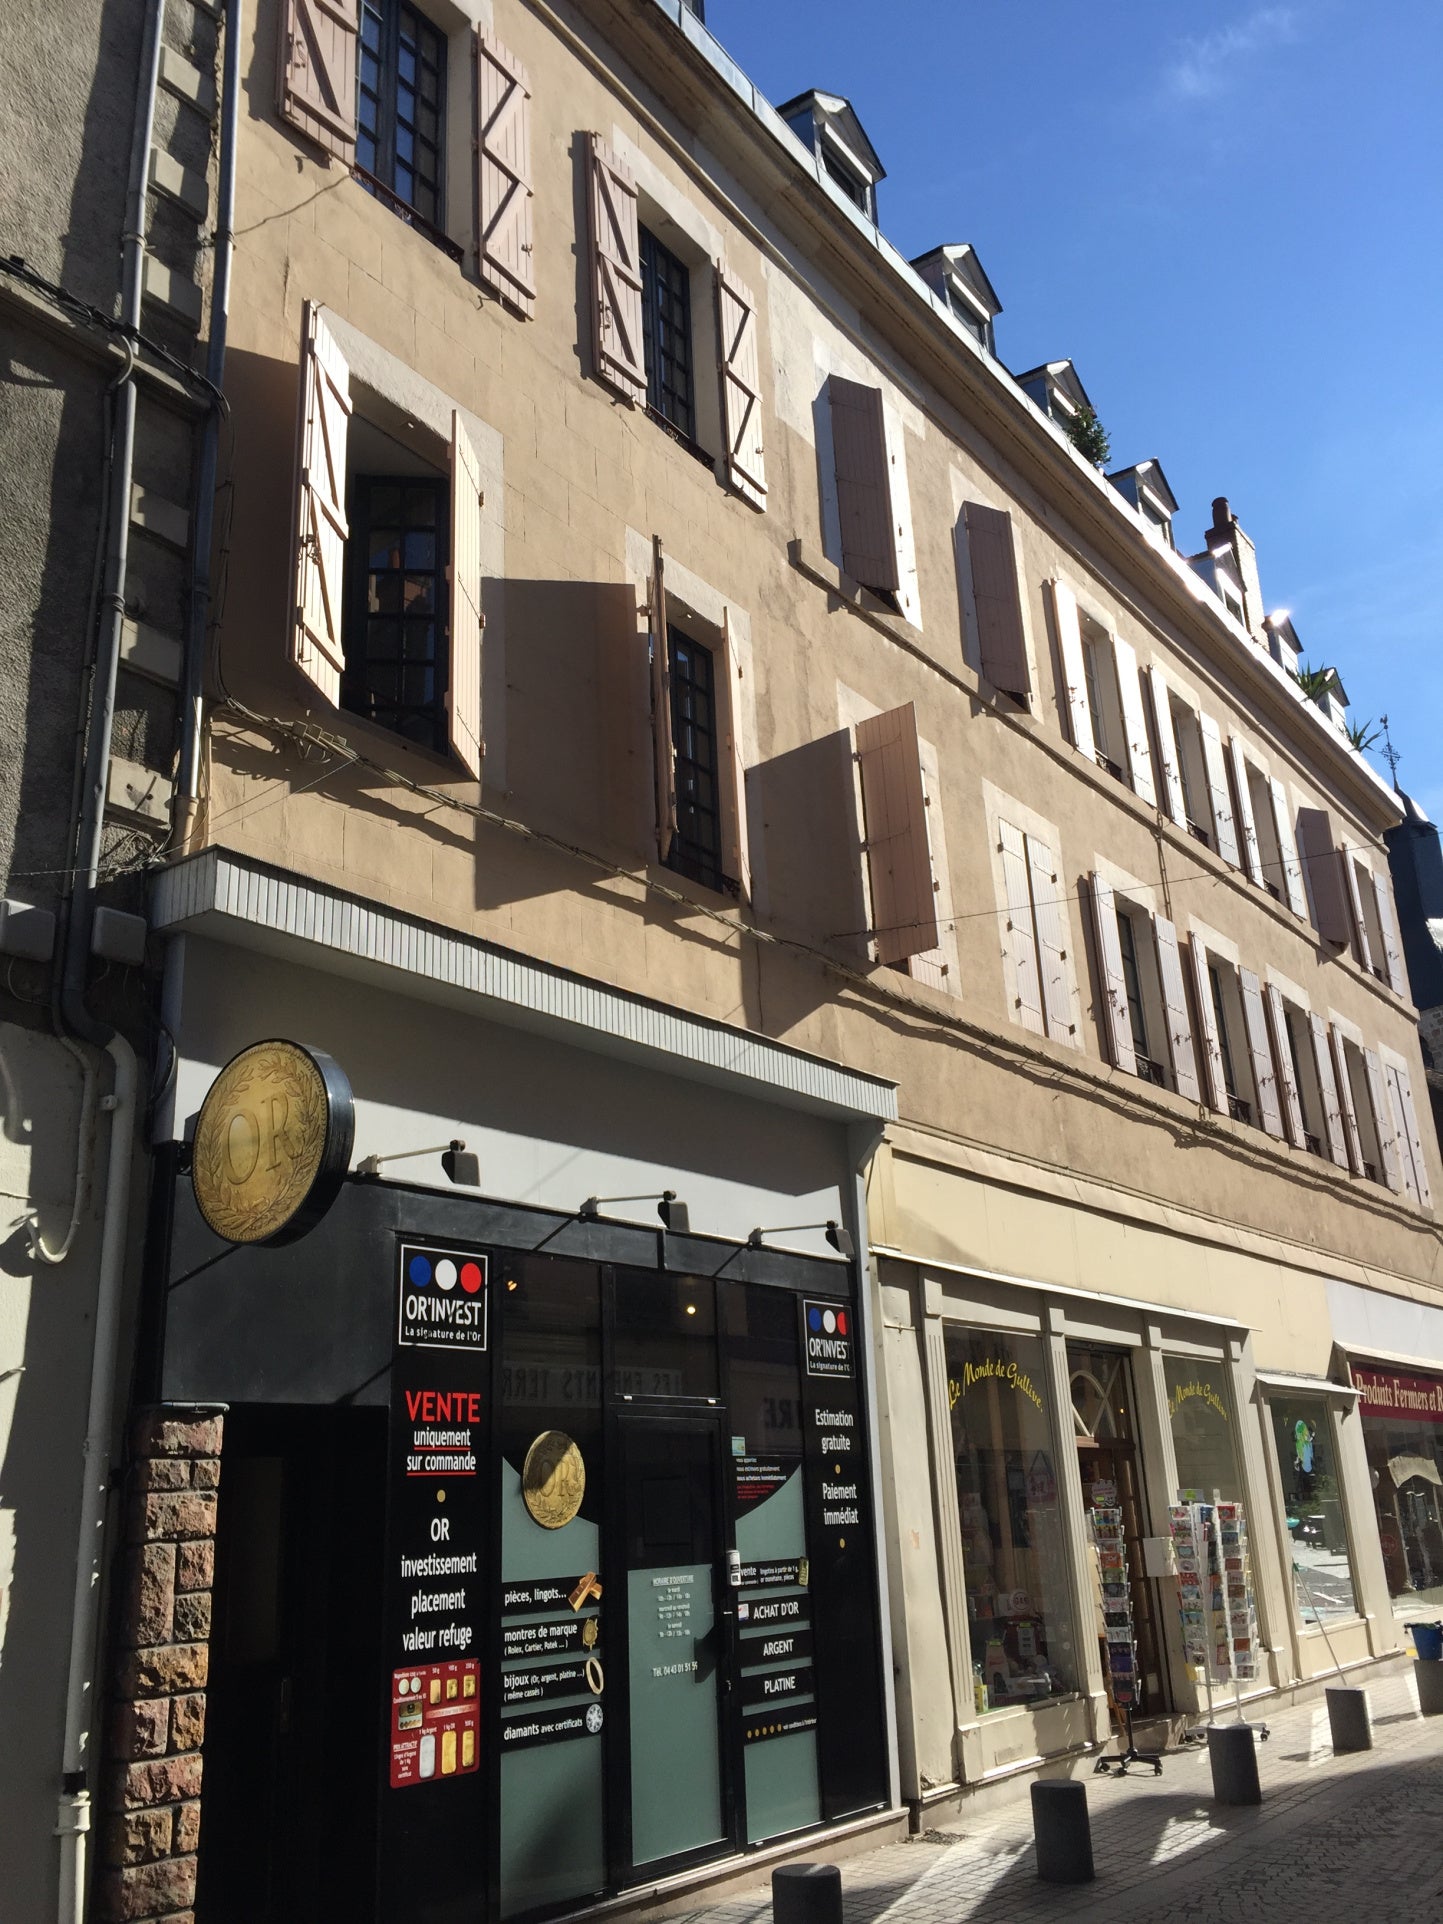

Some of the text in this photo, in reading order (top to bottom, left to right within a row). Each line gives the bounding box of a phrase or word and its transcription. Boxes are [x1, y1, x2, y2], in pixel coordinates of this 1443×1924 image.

[228, 1096, 304, 1186] OR
[405, 1294, 482, 1326] OR'INVEST
[405, 1325, 482, 1342] La signature de l'Or
[948, 1379, 961, 1411] Le
[962, 1357, 994, 1397] Monde
[995, 1358, 1006, 1378] de
[1355, 1373, 1393, 1407] Produits
[1393, 1379, 1429, 1411] Fermiers
[1429, 1390, 1437, 1412] et
[405, 1390, 481, 1423] VENTE
[814, 1408, 854, 1427] Estimation
[413, 1426, 471, 1448] uniquement
[821, 1434, 851, 1455] gratuite
[406, 1450, 477, 1472] sur commande
[822, 1482, 858, 1500] Paiement
[823, 1506, 859, 1526] immédiat
[430, 1517, 450, 1542] OR
[401, 1551, 478, 1578] investissement
[411, 1588, 466, 1620] placement
[504, 1587, 567, 1607] pièces, lingots...
[753, 1601, 800, 1620] ACHAT D'OR
[402, 1622, 472, 1652] valeur refuge
[504, 1623, 578, 1643] montres de marque
[763, 1638, 794, 1657] ARGENT
[503, 1674, 529, 1690] bijoux
[764, 1675, 796, 1695] PLATINE
[503, 1718, 583, 1741] diamants avec certificats
